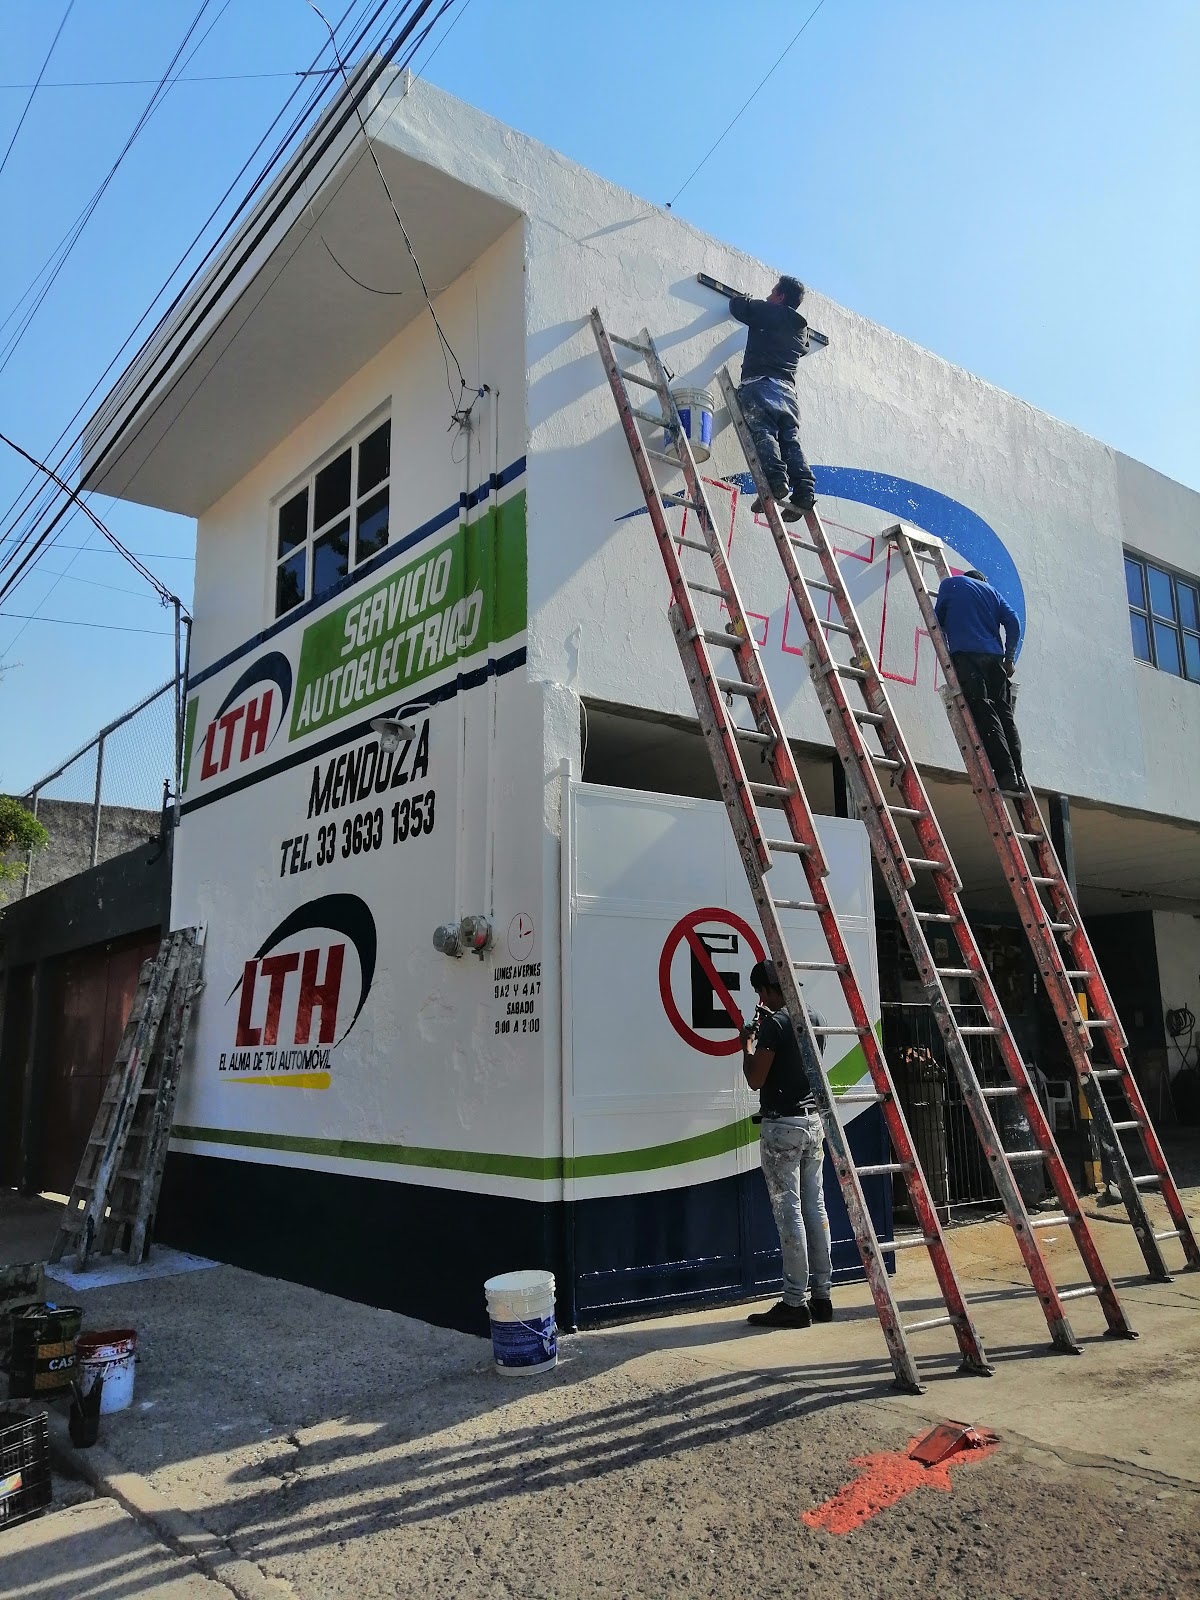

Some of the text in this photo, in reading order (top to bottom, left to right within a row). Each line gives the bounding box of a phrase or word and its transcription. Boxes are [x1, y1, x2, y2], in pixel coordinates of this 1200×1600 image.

[341, 549, 453, 657] SERVICIO
[296, 589, 484, 732] AUTOELECTRICO
[200, 688, 274, 781] LTH
[306, 718, 431, 820] MENDOZA
[280, 789, 436, 878] TEL. 33 3633 1353
[235, 943, 346, 1048] LTH
[507, 1000, 534, 1015] SABADO
[513, 1020, 518, 1033] A
[218, 1053, 228, 1071] EL
[228, 1051, 251, 1071] ALMA
[252, 1051, 264, 1071] DE
